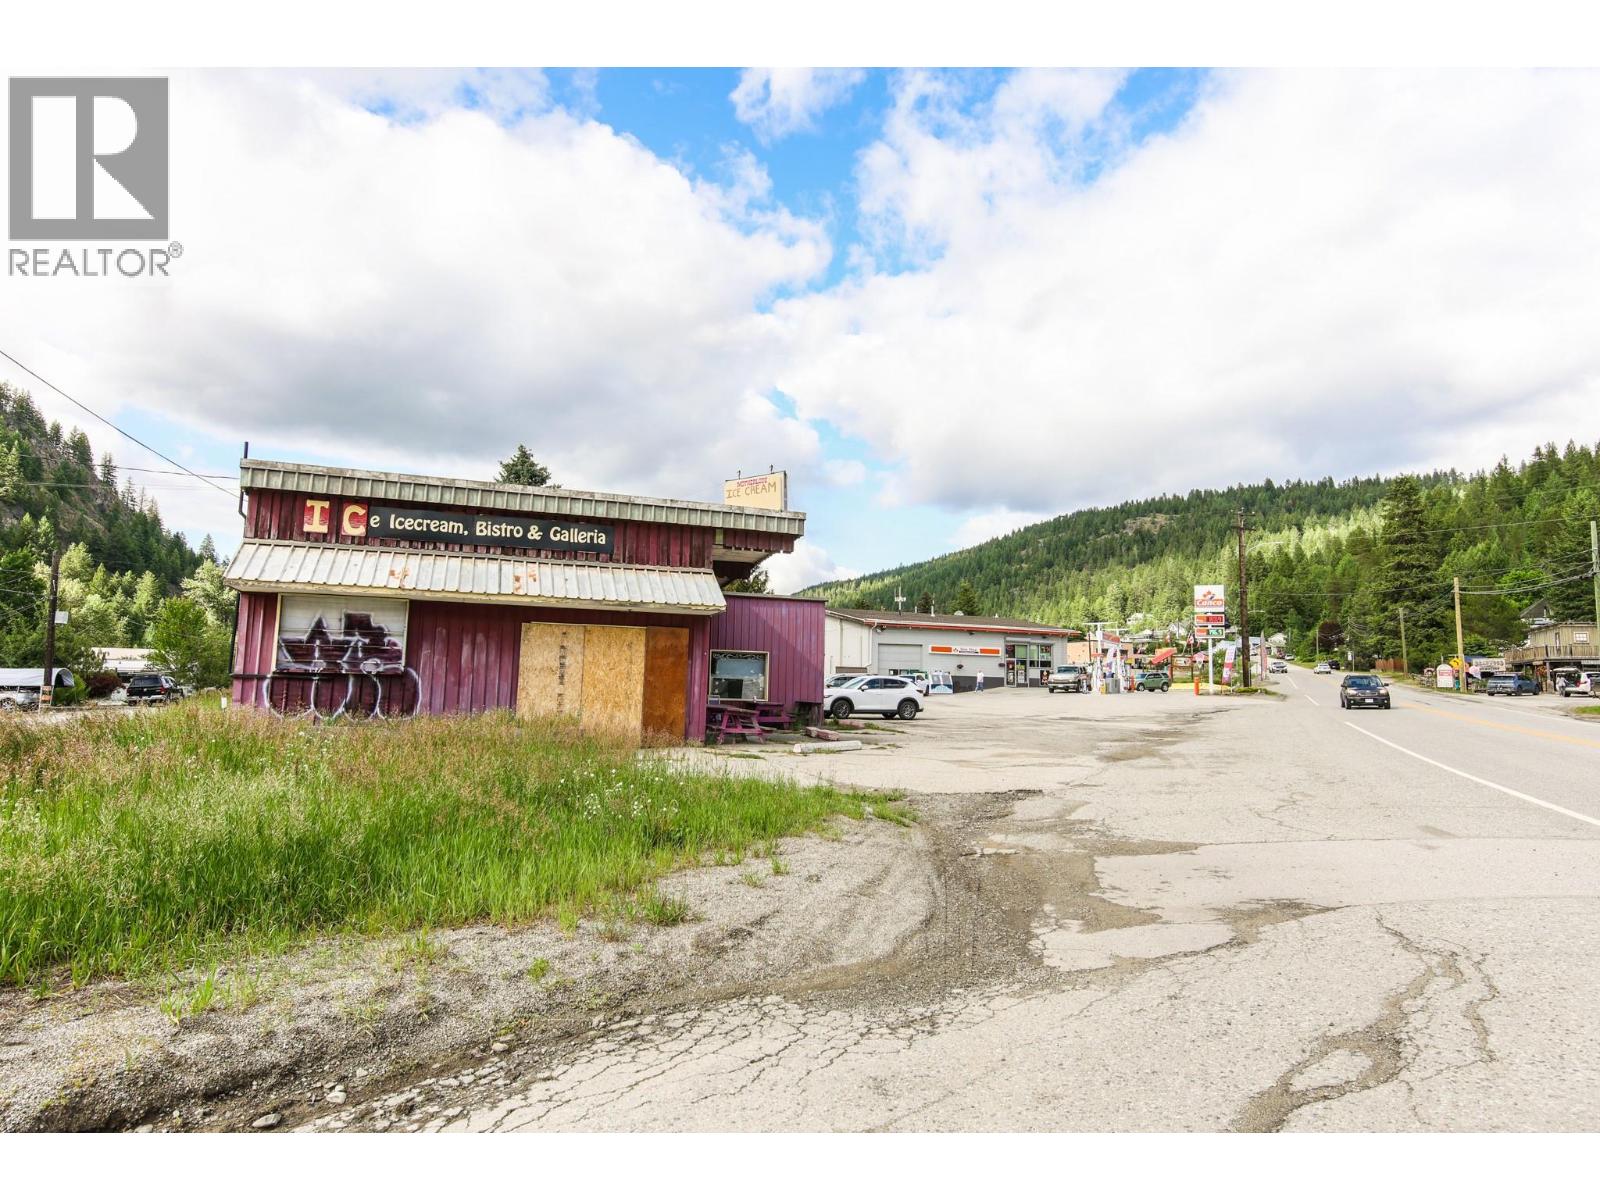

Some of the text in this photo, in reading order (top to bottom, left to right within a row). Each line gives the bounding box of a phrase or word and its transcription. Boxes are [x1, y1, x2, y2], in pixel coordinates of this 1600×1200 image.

[726, 488, 742, 499] ICE
[744, 481, 777, 497] CREAM
[475, 521, 524, 538] Bistro
[527, 525, 543, 540] &
[549, 526, 606, 545] Galleria
